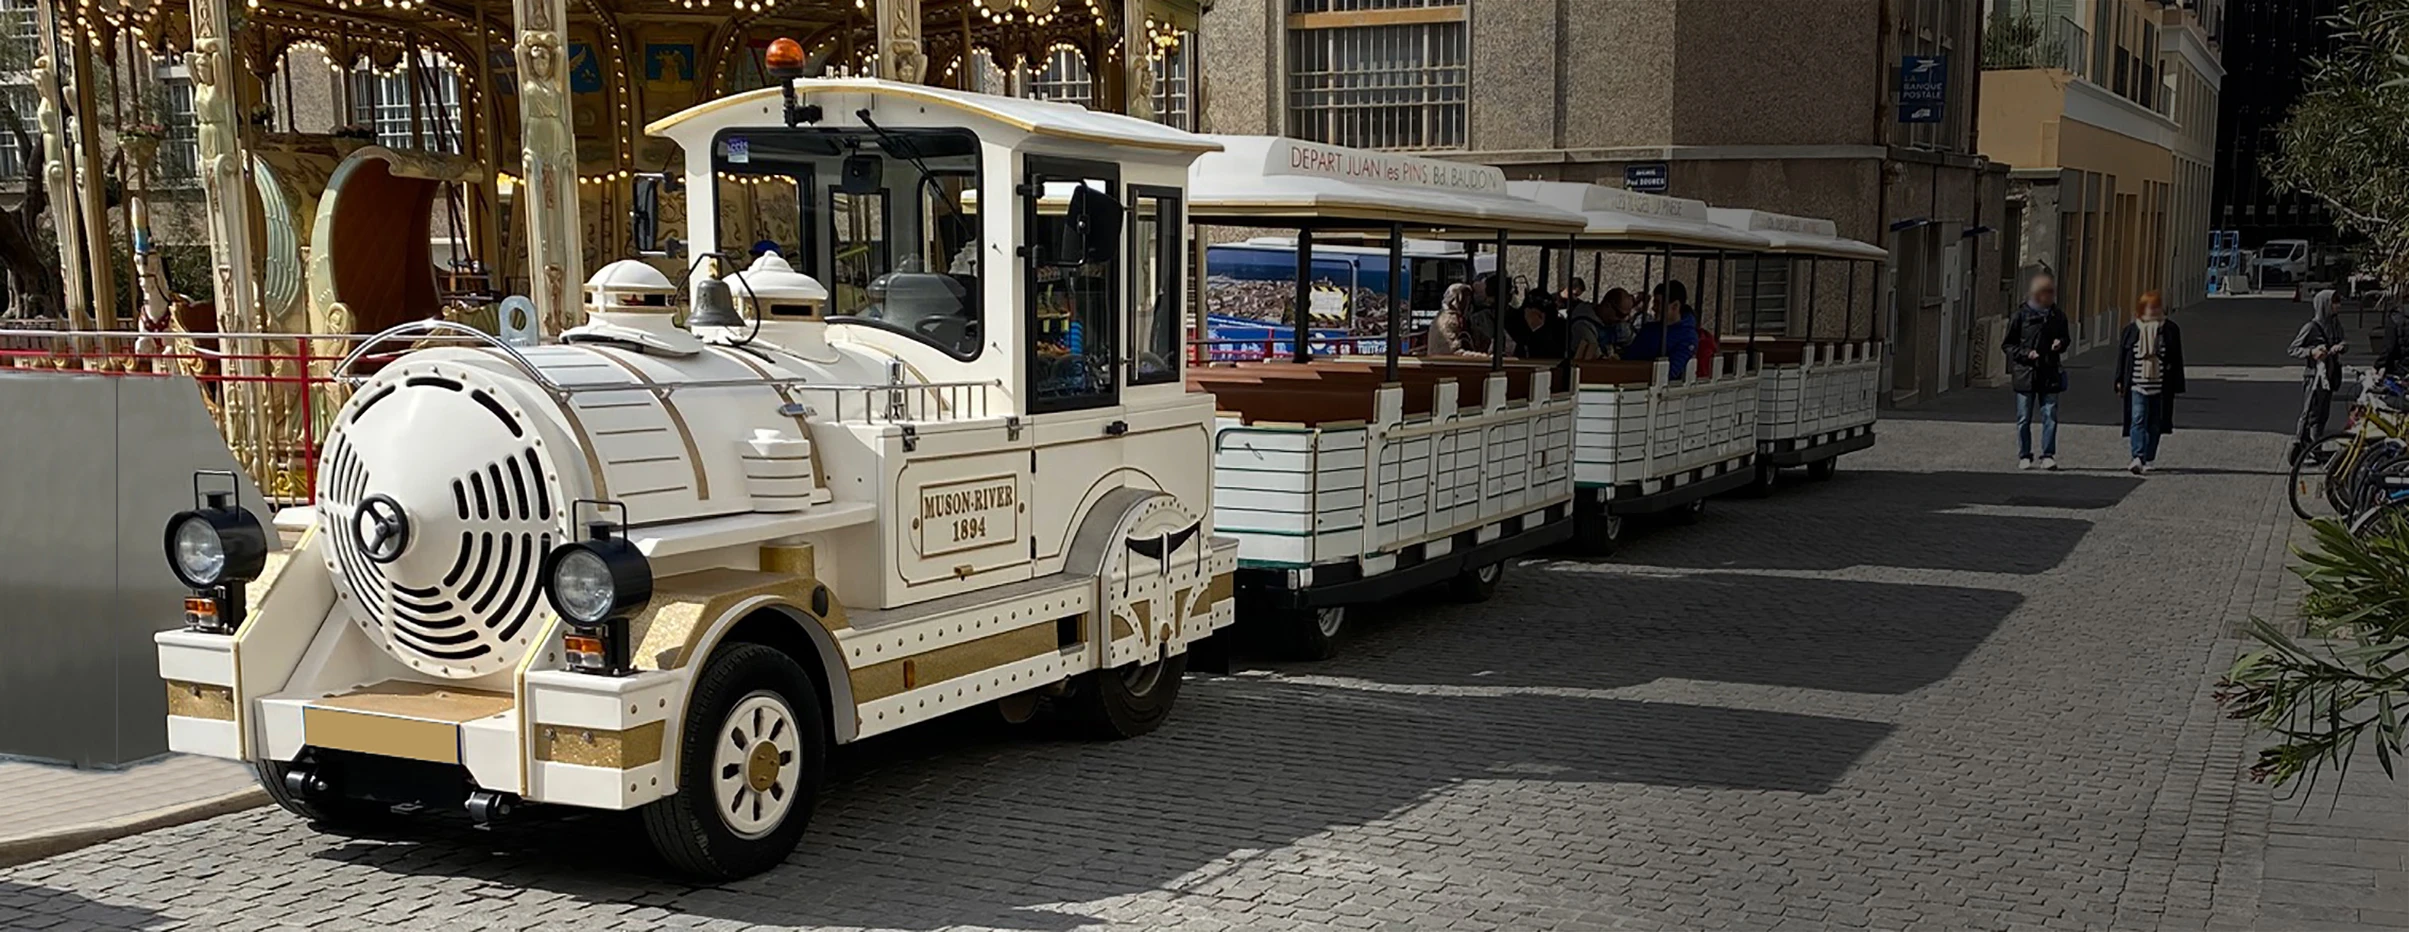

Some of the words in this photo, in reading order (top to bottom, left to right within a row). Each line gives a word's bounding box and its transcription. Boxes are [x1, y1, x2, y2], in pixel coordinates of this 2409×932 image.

[1903, 83, 1943, 91] BANQUE
[1903, 91, 1943, 99] POSTALE
[1291, 146, 1343, 172] DEPART
[1346, 154, 1380, 177] JUAN
[1384, 159, 1399, 181] les
[1403, 162, 1428, 184] PINS
[953, 516, 986, 542] 1894
